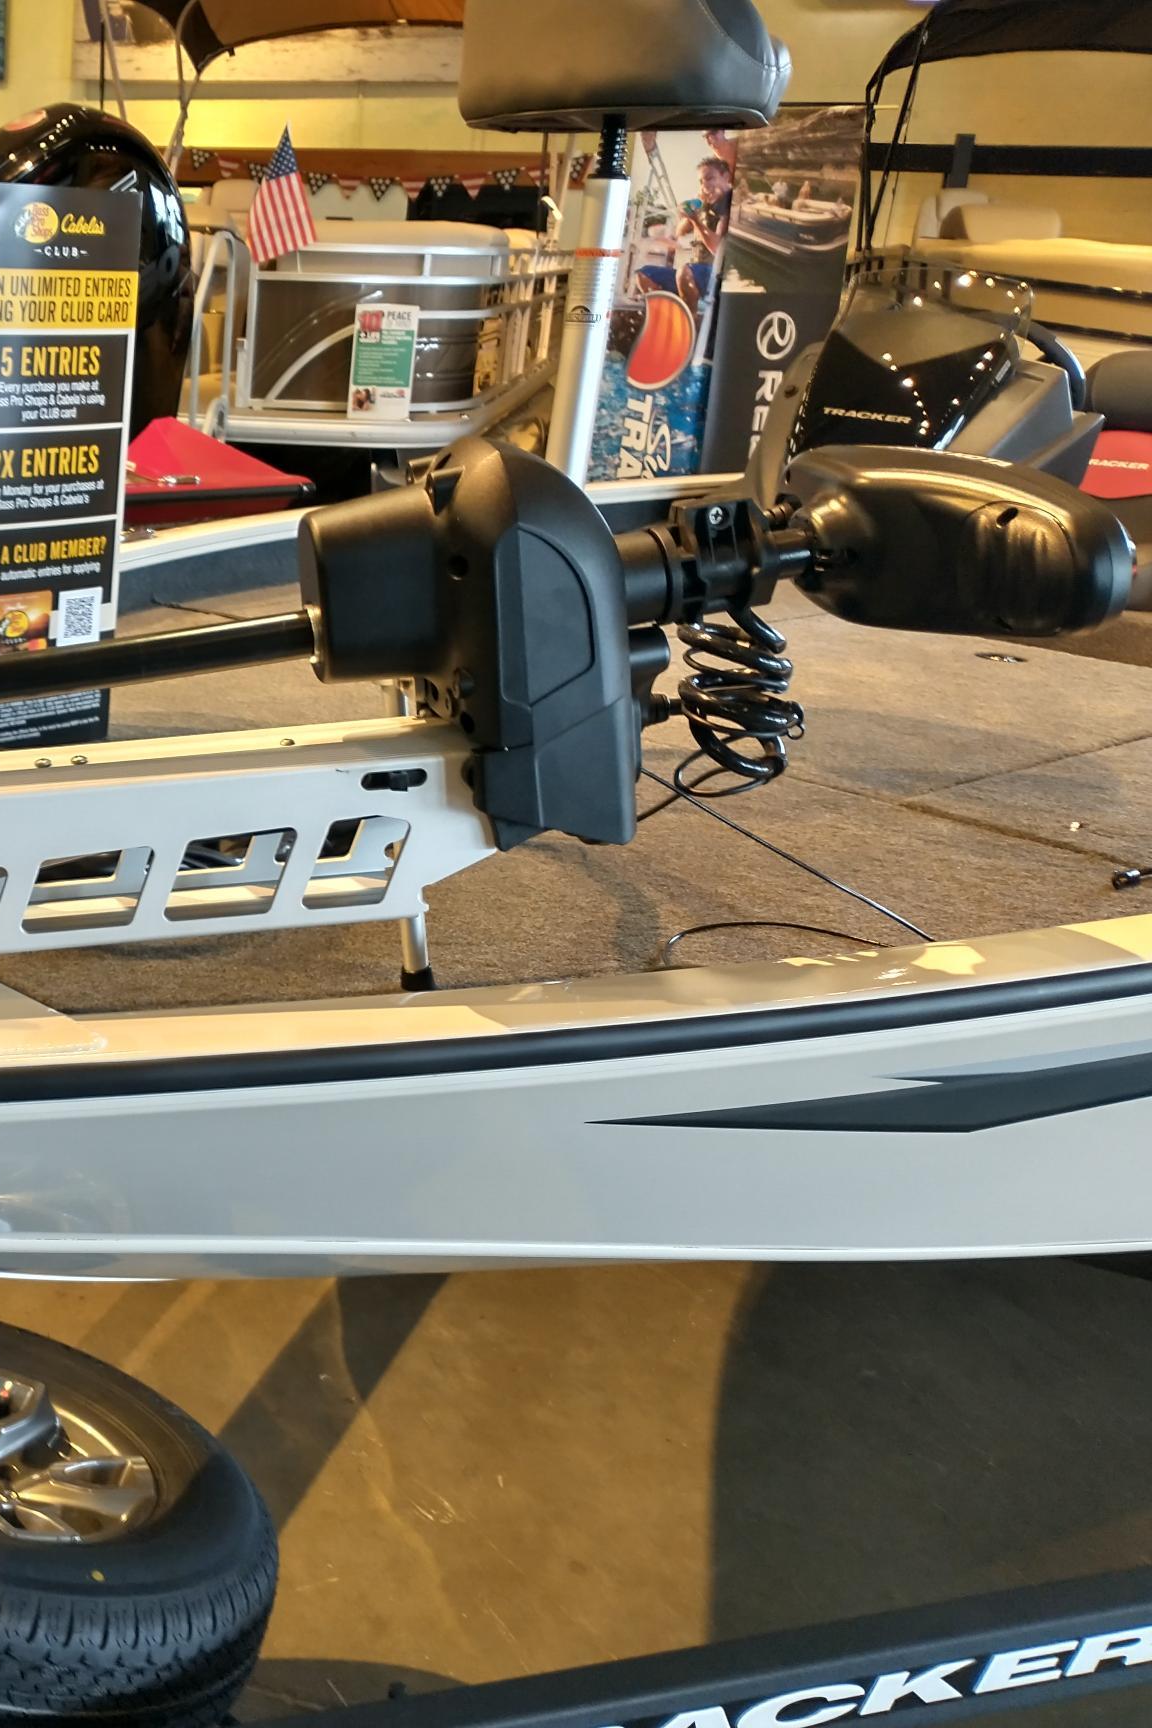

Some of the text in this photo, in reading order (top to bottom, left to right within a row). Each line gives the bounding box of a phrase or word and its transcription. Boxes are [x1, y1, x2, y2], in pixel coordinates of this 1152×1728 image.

[44, 245, 79, 258] CLUB
[10, 276, 81, 297] UNLIMITED
[85, 277, 131, 298] ENTRIES
[19, 300, 56, 322] YOUR
[61, 301, 94, 322] CLUB
[0, 345, 101, 377] 5 ENTRIES
[22, 381, 56, 393] purchase
[56, 382, 70, 393] you
[71, 380, 90, 391] make
[91, 380, 99, 391] at
[10, 395, 23, 406] Pro
[24, 394, 48, 408] Shops
[49, 394, 55, 406] &
[56, 393, 86, 405] Cabela's
[87, 394, 105, 407] using
[21, 407, 77, 422] your CLUB card
[823, 406, 912, 425] TRACKER
[21, 444, 100, 478] ENTRIES
[2, 484, 32, 497] Monday
[33, 483, 44, 494] for
[45, 484, 61, 496] your
[61, 480, 96, 494] purchases
[96, 478, 104, 490] at
[15, 497, 29, 509] Pro
[29, 496, 53, 511] Shops
[60, 493, 90, 506] Cabela's
[0, 545, 10, 565] A
[13, 542, 47, 564] CLUB
[50, 536, 107, 560] MEMBER?
[0, 567, 37, 581] automatic
[37, 565, 62, 578] entries
[62, 562, 73, 575] for
[72, 561, 101, 576] applying
